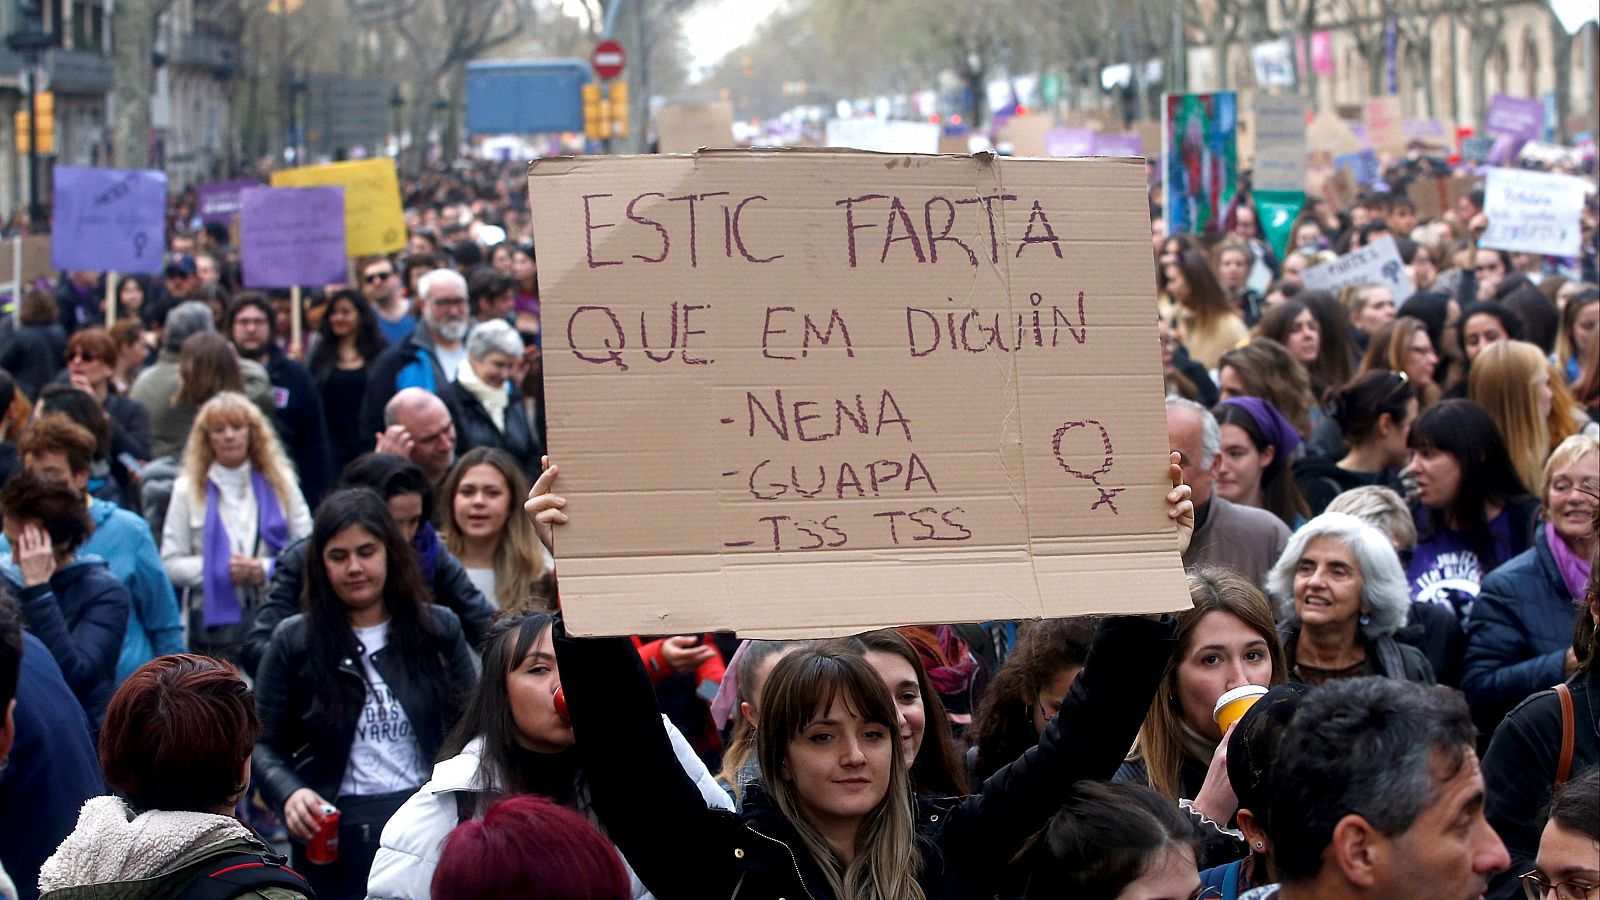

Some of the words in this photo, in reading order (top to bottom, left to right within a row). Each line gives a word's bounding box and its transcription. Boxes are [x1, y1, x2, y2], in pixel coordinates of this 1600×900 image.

[583, 191, 784, 268] ESTIC
[836, 193, 1063, 268] FARTA
[567, 302, 715, 371] QUE
[762, 308, 854, 360] EM
[873, 506, 972, 544] TSS
[366, 704, 399, 723] DOS
